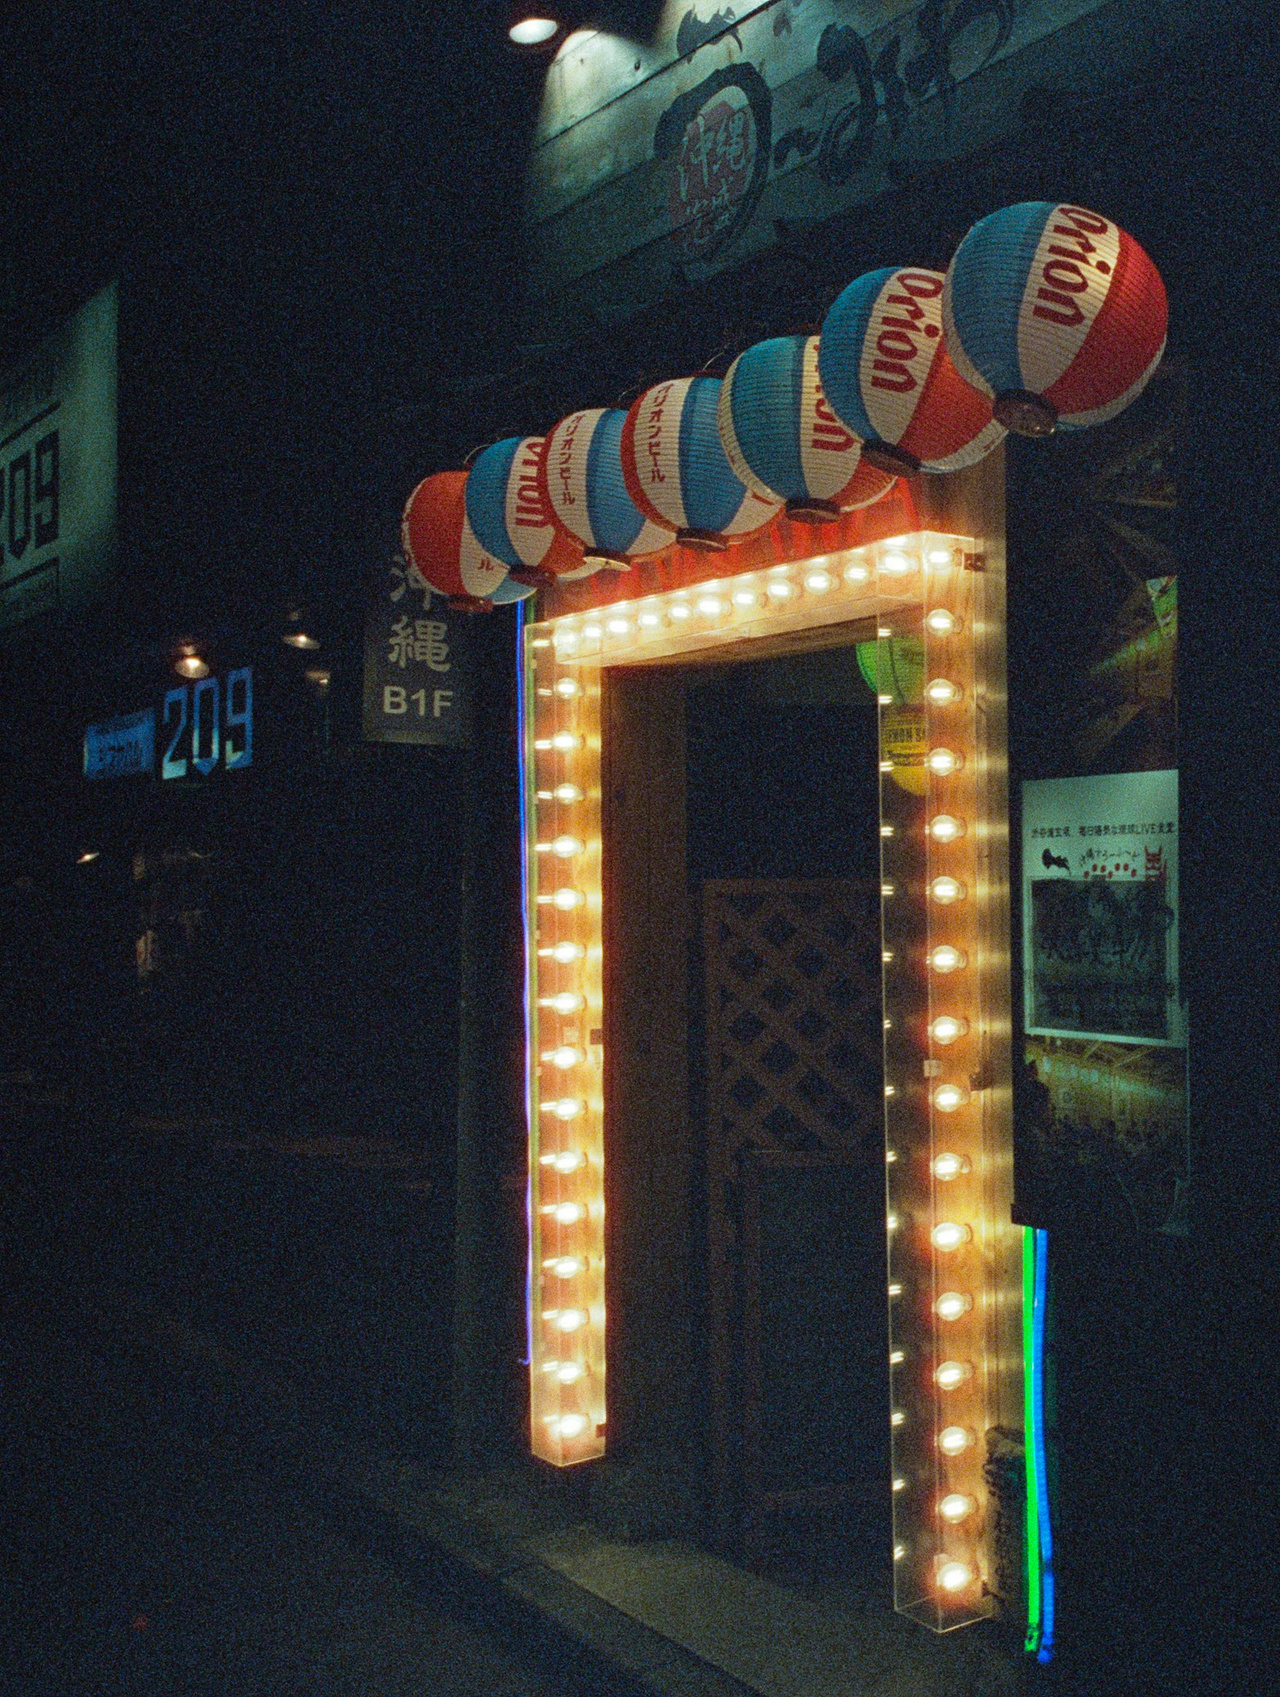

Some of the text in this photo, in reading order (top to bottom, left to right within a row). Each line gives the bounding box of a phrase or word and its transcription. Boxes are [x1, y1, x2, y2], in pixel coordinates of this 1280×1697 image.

[1032, 204, 1108, 327] Orion
[871, 272, 944, 393] Orion
[648, 383, 675, 483] オリオンビール
[0, 430, 59, 566] 09
[161, 667, 253, 780] 209
[383, 684, 453, 718] B1F
